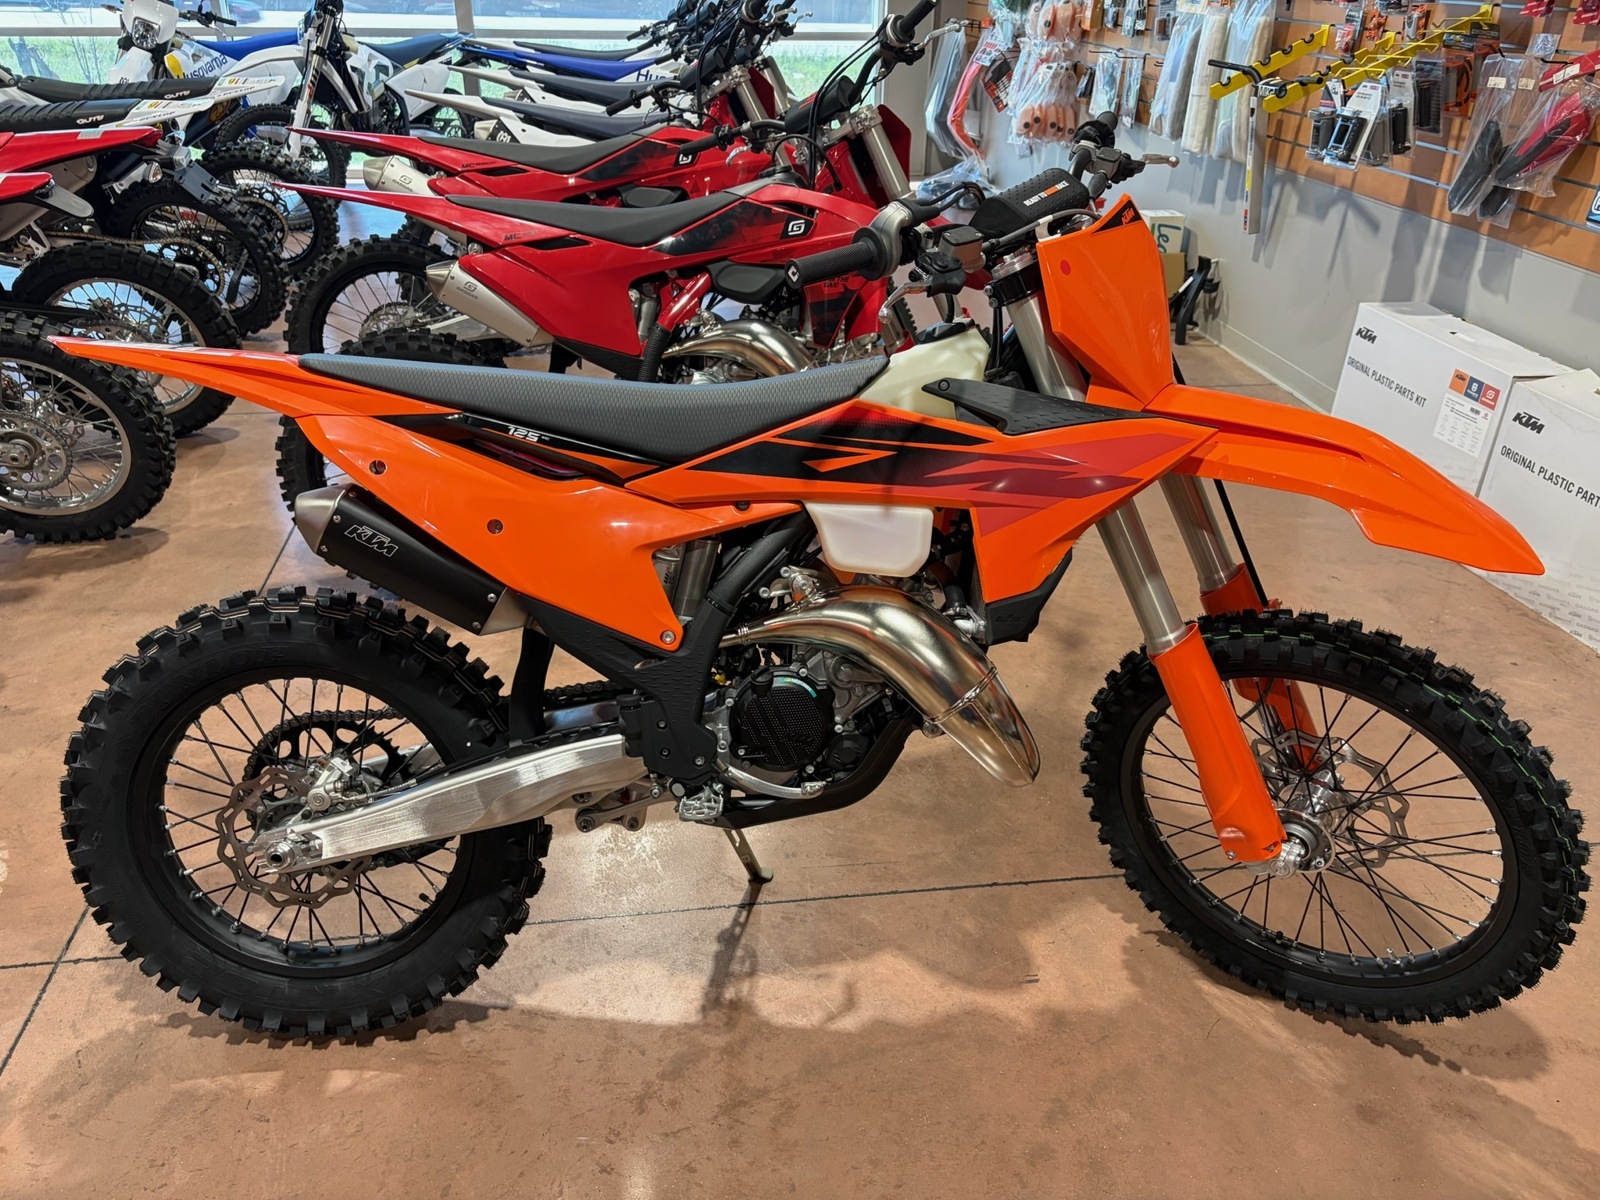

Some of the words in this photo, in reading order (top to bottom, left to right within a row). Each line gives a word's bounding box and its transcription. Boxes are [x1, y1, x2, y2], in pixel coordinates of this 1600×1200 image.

[177, 54, 228, 79] usqvarna
[1121, 207, 1136, 226] KTM
[504, 232, 522, 241] MC
[1355, 326, 1378, 345] KTM
[1347, 356, 1370, 377] ORIGINAL
[1370, 369, 1396, 390] PLASTIC
[1393, 382, 1415, 402] PARTS
[1413, 392, 1428, 408] KIT
[507, 426, 540, 442] 125
[1512, 411, 1545, 434] KTM
[1500, 445, 1536, 474] ORIGINAL
[1537, 465, 1575, 494] PLASTIC
[344, 524, 399, 557] KTM
